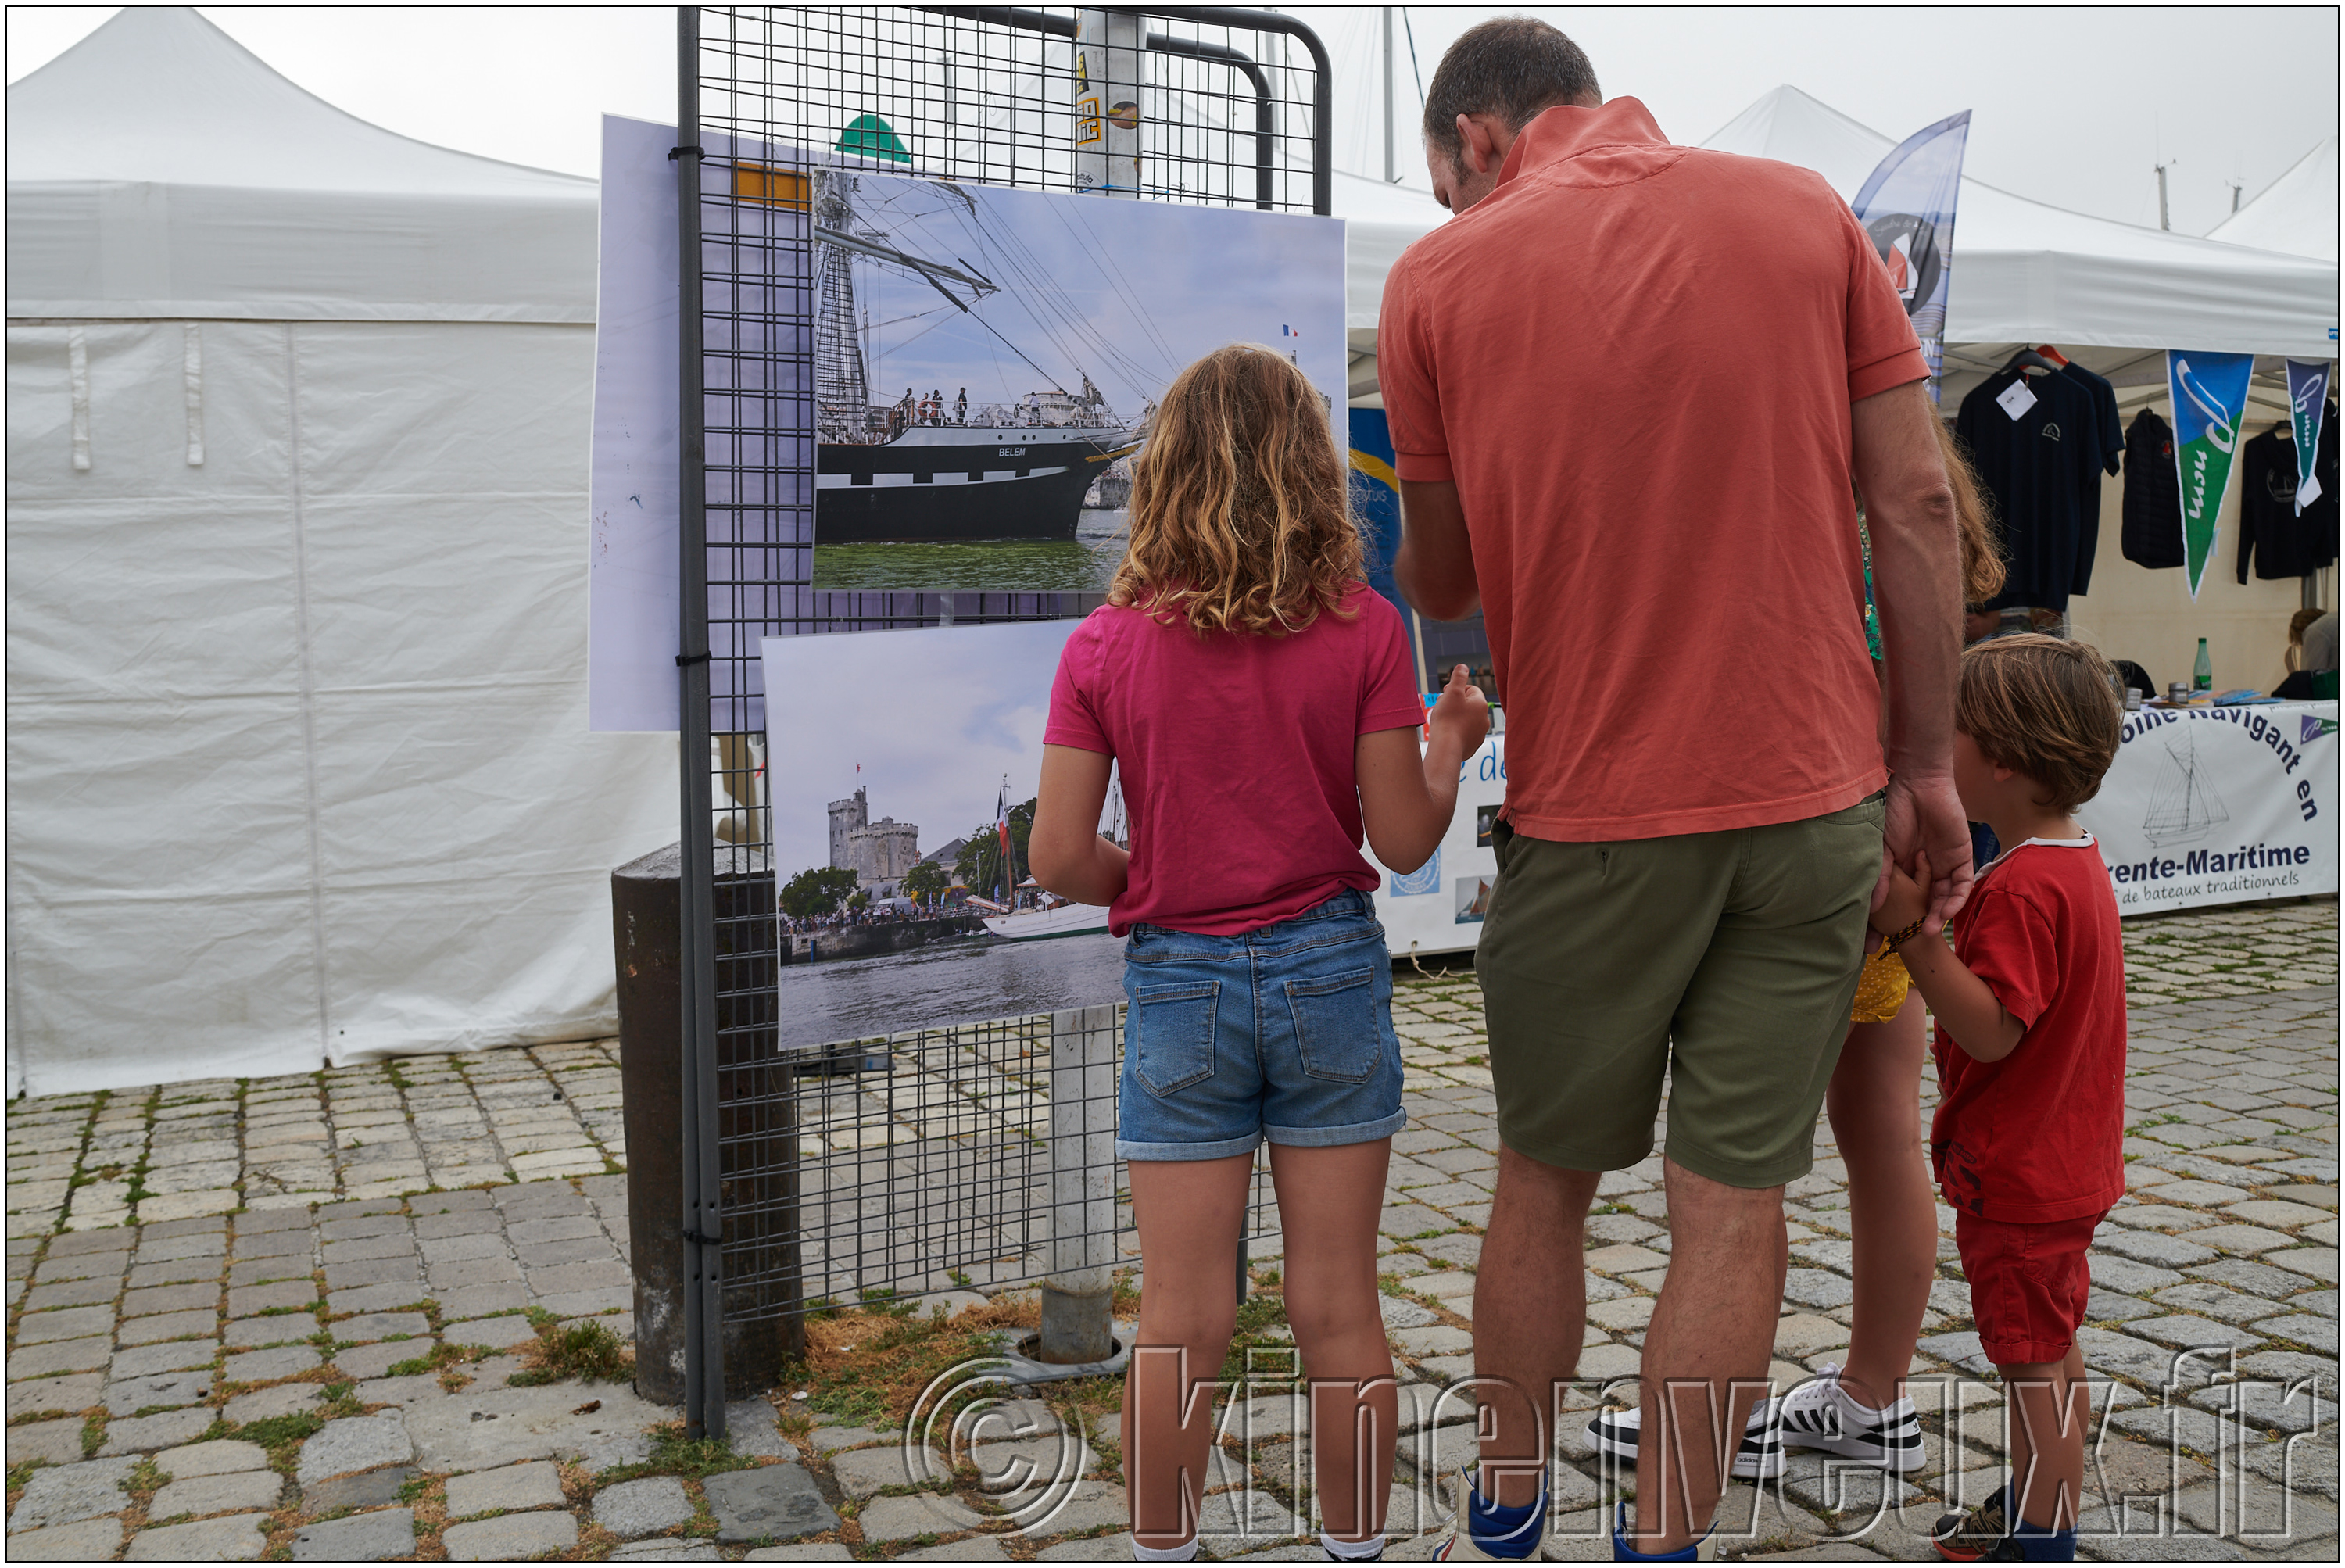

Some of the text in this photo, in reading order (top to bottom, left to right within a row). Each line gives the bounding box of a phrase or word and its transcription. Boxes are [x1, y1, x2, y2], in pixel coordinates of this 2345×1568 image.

[999, 448, 1026, 456] BELEM
[2297, 779, 2318, 822] en
[2122, 889, 2139, 904] de
[2144, 886, 2201, 900] bateaux
[2207, 870, 2300, 894] traditionnels
